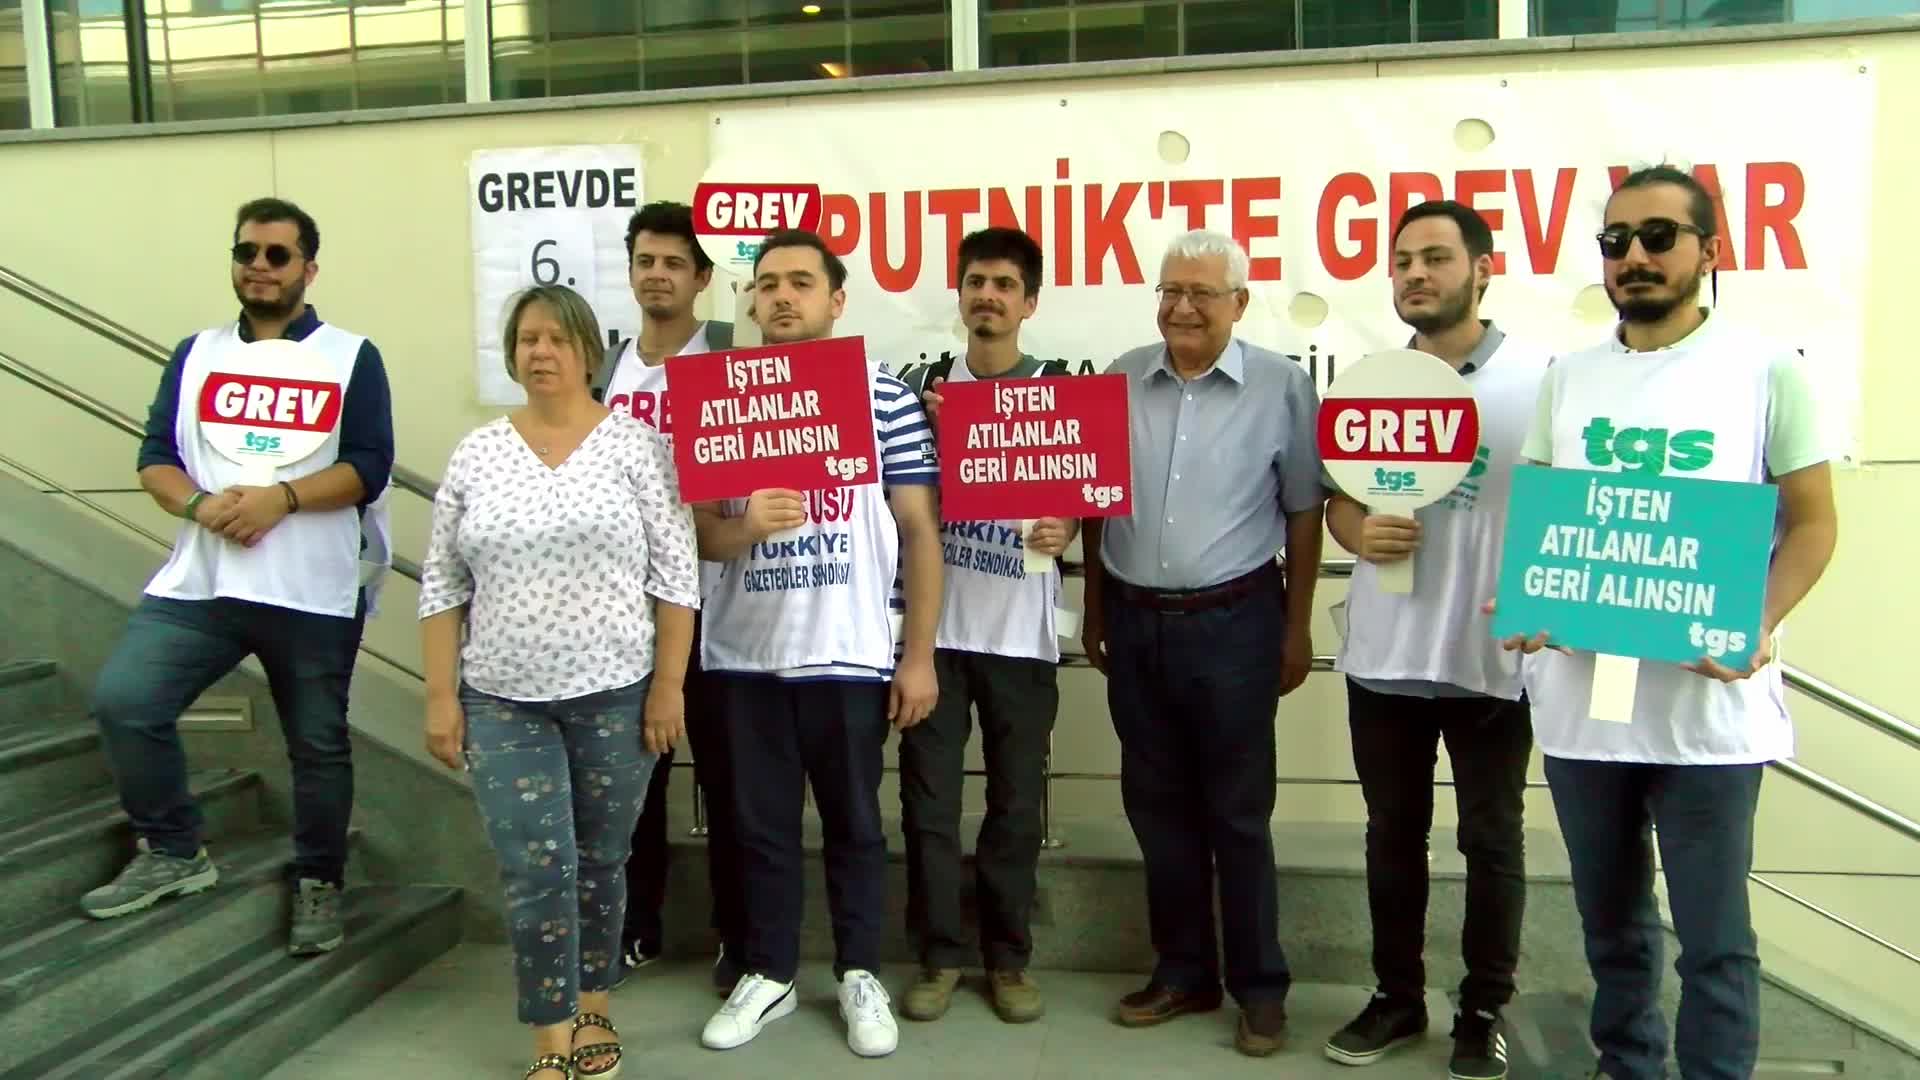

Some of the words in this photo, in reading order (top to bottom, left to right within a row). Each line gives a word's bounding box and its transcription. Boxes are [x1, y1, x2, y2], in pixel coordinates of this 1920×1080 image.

[478, 168, 636, 213] GREVDE
[706, 192, 809, 229] GREV
[532, 239, 576, 287] 6.
[725, 355, 792, 394] İŞTEN
[215, 382, 330, 425] GREV
[700, 389, 821, 428] ATILANLAR
[994, 383, 1056, 419] İŞTEN
[245, 432, 280, 452] tgs
[694, 428, 745, 464] GERİ
[752, 424, 840, 459] ALINSIN
[967, 419, 1081, 449] ATILANLAR
[1334, 408, 1464, 453] GREV
[1582, 417, 1715, 476] tgs
[825, 456, 868, 481] tgs
[959, 451, 1007, 484] GERİ
[1014, 453, 1097, 481] ALINSIN
[1374, 467, 1416, 491] tgs
[1082, 483, 1124, 508] tgs
[1585, 478, 1671, 526] İŞTEN
[1540, 524, 1699, 570] ATILANLAR
[1524, 564, 1591, 602] GERİ
[1596, 573, 1716, 616] ALINSIN
[1688, 622, 1746, 657] tgs
